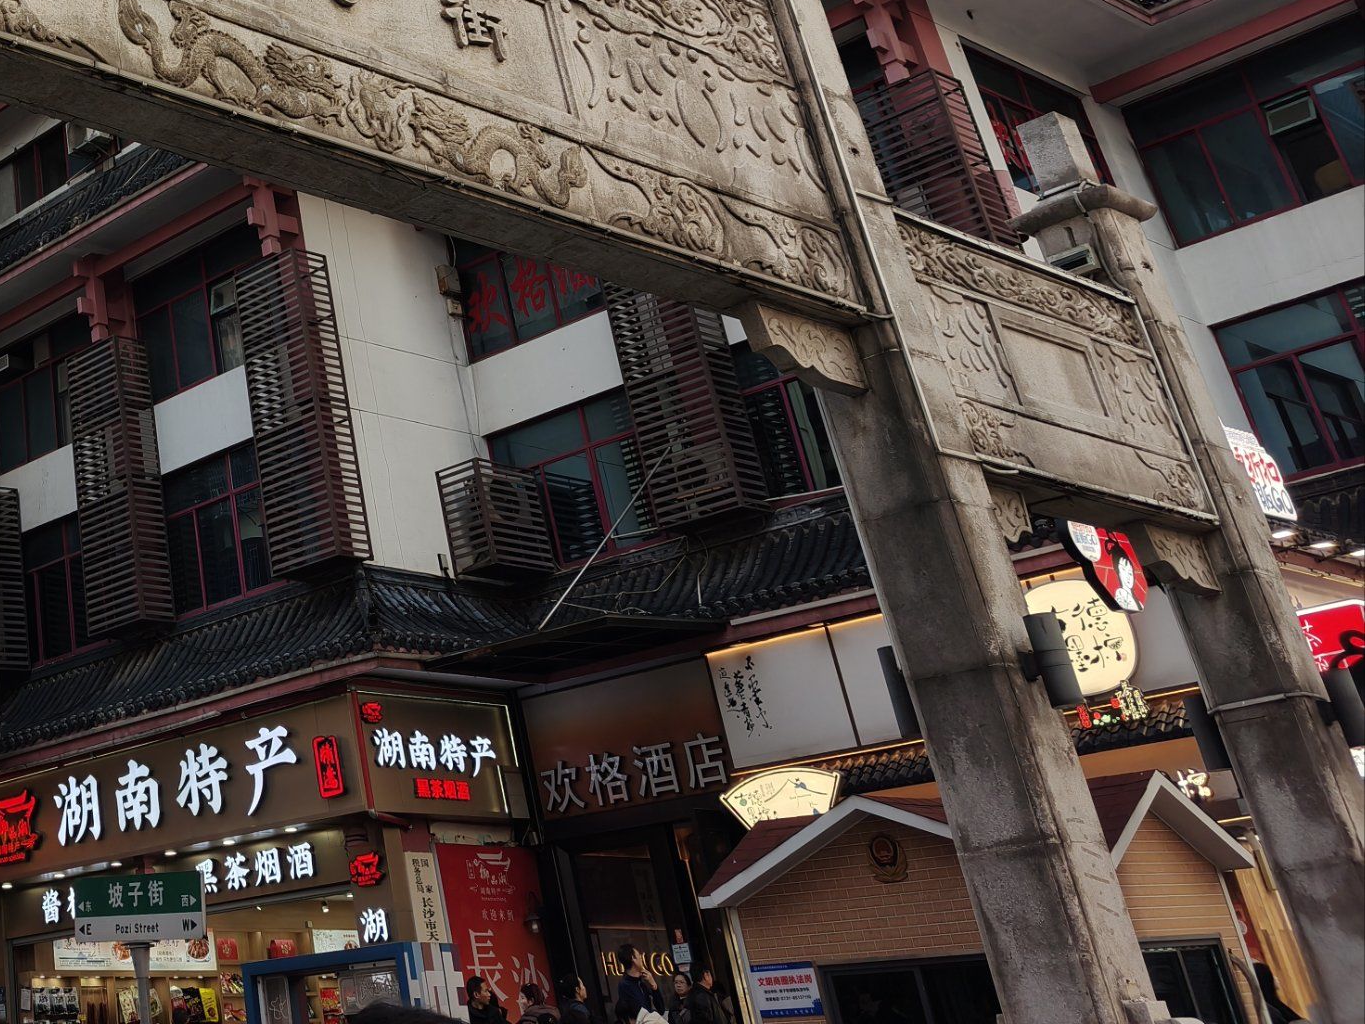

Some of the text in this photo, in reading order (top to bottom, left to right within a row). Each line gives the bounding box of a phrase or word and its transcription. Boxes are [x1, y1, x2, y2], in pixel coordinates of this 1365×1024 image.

[373, 728, 496, 777] 湖南特产
[541, 732, 729, 814] 欢格酒店
[53, 724, 298, 847] 湖南特产
[415, 778, 471, 801] 黑茶烟酒
[195, 841, 314, 894] 黑茶烟酒
[108, 880, 164, 909] 坡子街
[181, 894, 190, 907] 西
[84, 901, 92, 913] 东
[86, 924, 92, 936] E
[115, 922, 159, 935] Pozi Street
[182, 919, 191, 931] W
